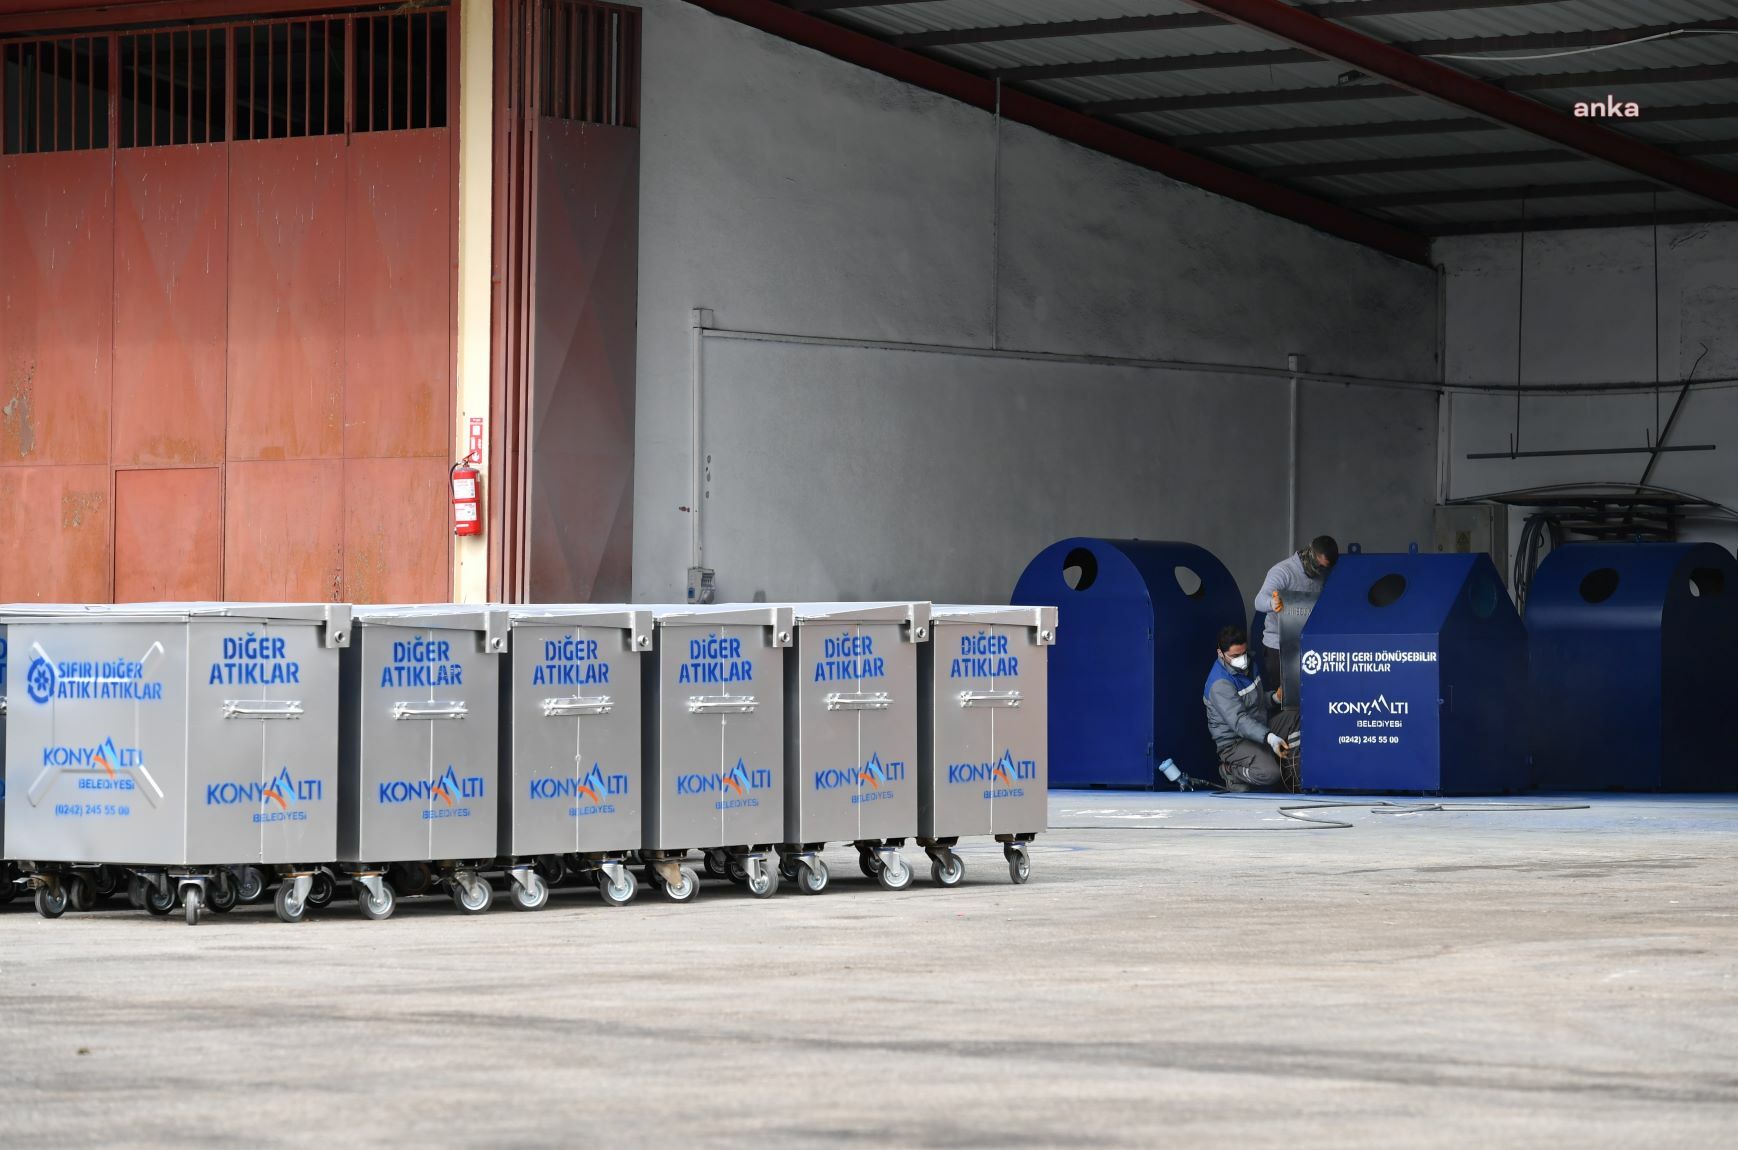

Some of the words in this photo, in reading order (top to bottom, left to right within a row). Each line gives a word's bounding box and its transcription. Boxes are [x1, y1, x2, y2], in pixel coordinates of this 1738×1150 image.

[1322, 651, 1346, 662] SIFIR
[58, 660, 92, 679] SIFIR
[209, 662, 300, 686] ATIKLAR
[381, 664, 462, 687] ATIKLAR
[533, 663, 609, 686] ATIKLAR
[679, 660, 752, 684] ATIKLAR
[815, 656, 885, 682] ATIKLAR
[950, 656, 1018, 678] ATIKLAR
[1322, 662, 1346, 672] ATIK
[1352, 663, 1391, 672] ATIKLAR
[58, 681, 91, 699] ATIK
[100, 681, 163, 700] ATIKLAR
[1338, 736, 1361, 745] (0242)
[1363, 736, 1376, 744] 245
[1378, 736, 1388, 744] 55
[1389, 736, 1399, 744] 00
[55, 804, 83, 816] (0242)
[85, 804, 102, 816] 245
[104, 804, 116, 816] 55
[118, 805, 130, 816] 00
